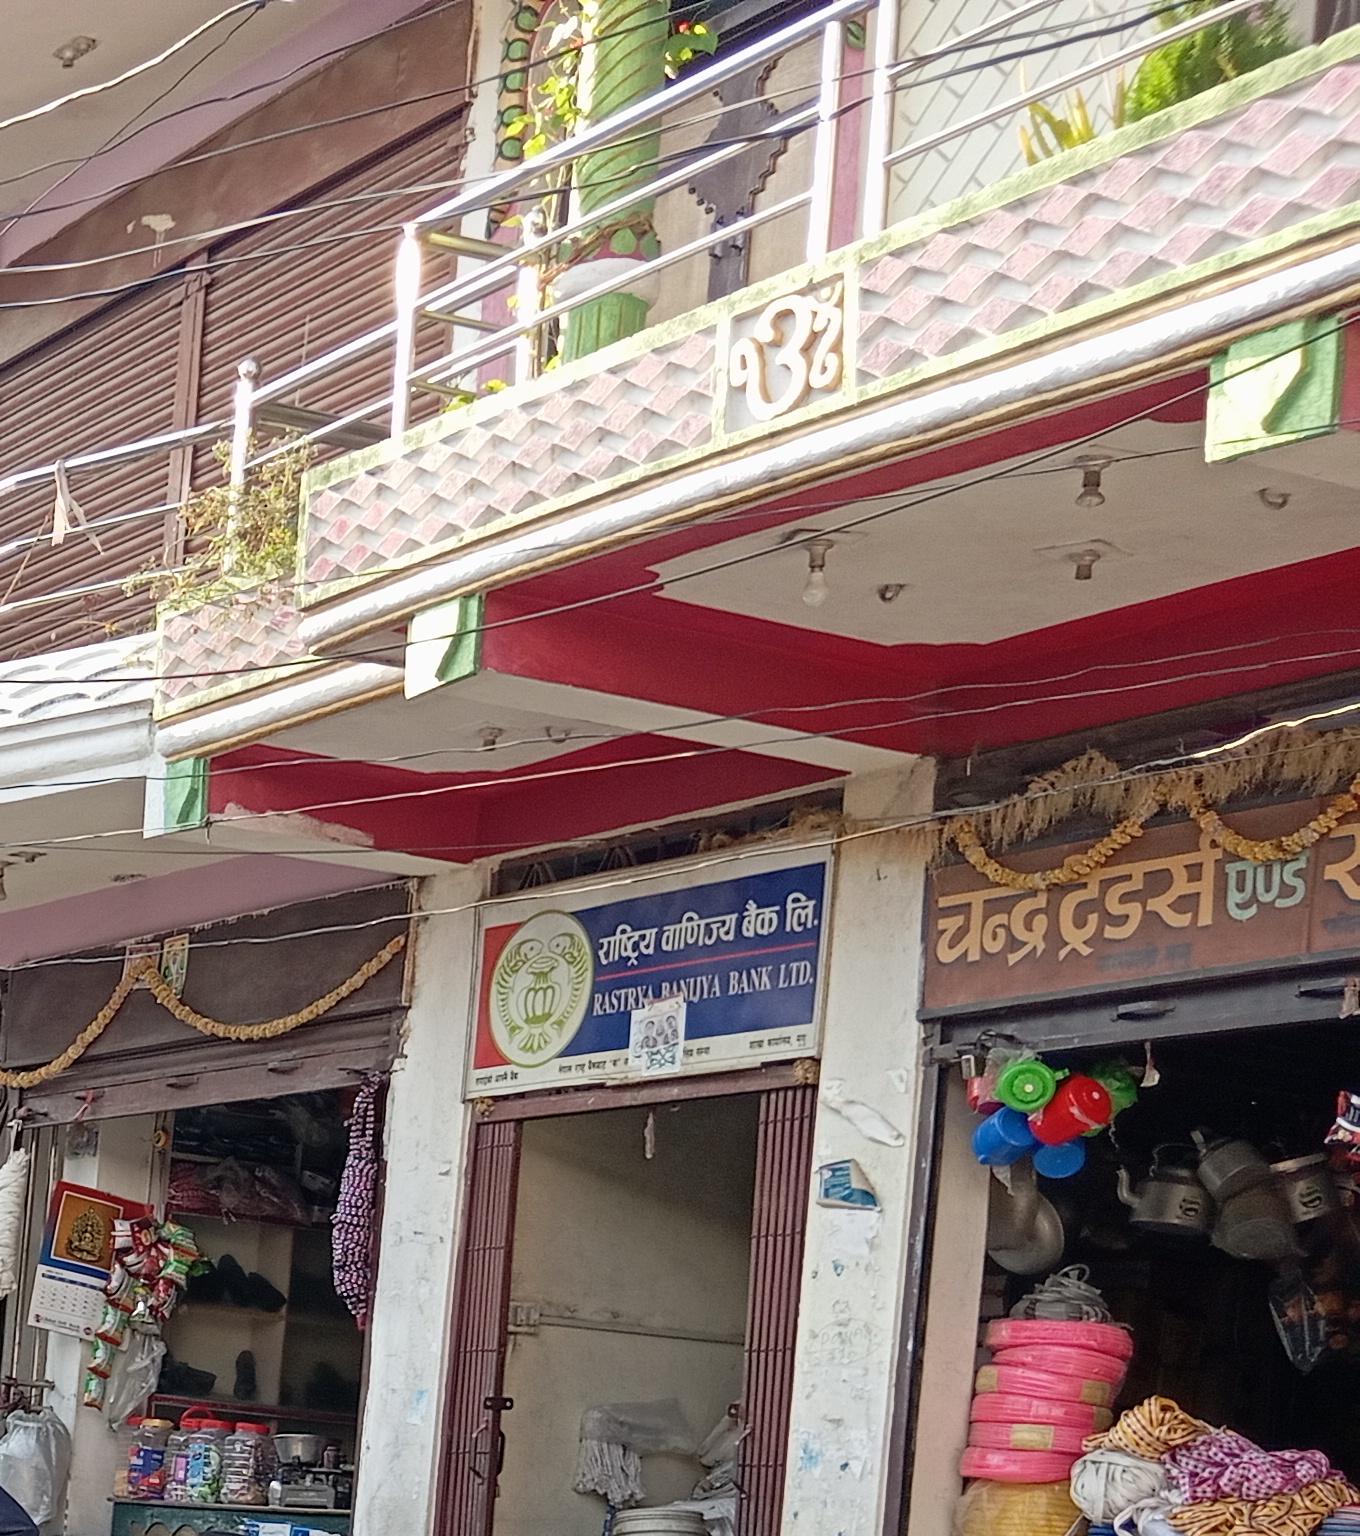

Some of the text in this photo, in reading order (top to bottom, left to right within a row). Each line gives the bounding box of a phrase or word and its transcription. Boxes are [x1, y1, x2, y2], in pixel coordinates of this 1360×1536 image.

[599, 892, 820, 967] राष्ट्रिय वाणिज्य बैंक लि.
[935, 882, 1049, 967] चन्द्र
[728, 966, 773, 997] BANK
[778, 960, 815, 989] LTD.
